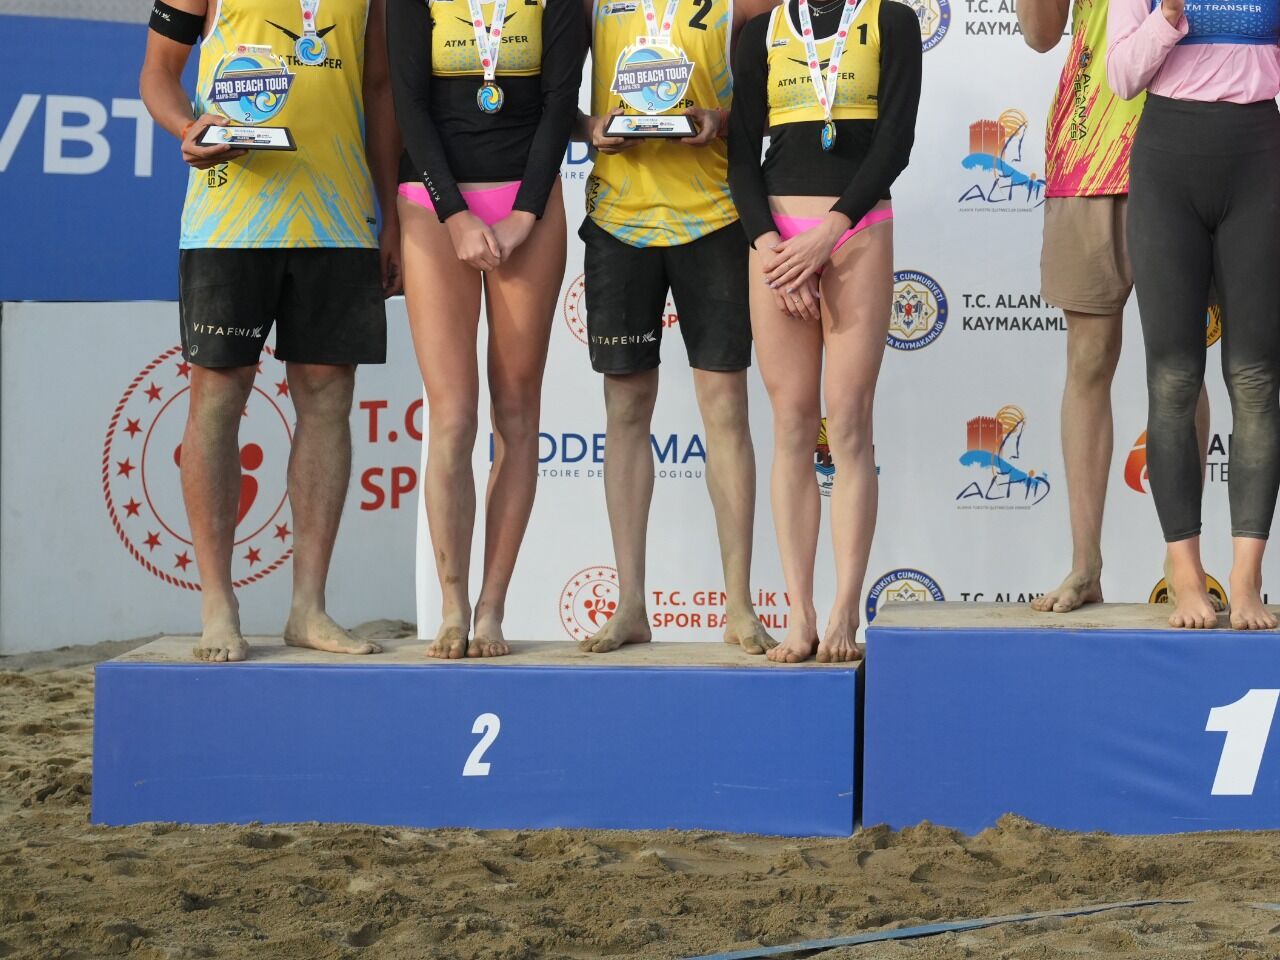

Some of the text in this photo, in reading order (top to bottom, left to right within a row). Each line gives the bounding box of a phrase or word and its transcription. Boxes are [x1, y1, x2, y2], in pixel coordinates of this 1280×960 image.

[965, 0, 994, 13] T.C.
[1183, 3, 1262, 13] TM TRANSFER
[444, 35, 528, 48] ATM TSFER
[856, 23, 868, 45] 1
[618, 66, 688, 85] PRO BEACH TOUR
[778, 72, 855, 88] ATM TRNFER
[215, 77, 289, 94] PRO BEACH TOUR
[962, 294, 990, 309] T.C.
[962, 316, 1068, 331] KAYMAKAML
[360, 467, 417, 511] SP
[870, 573, 897, 599] TÜRKİYE
[653, 592, 686, 606] T.C.
[653, 613, 702, 628] SPOR
[462, 712, 501, 777] 2
[1205, 688, 1280, 795] 1
